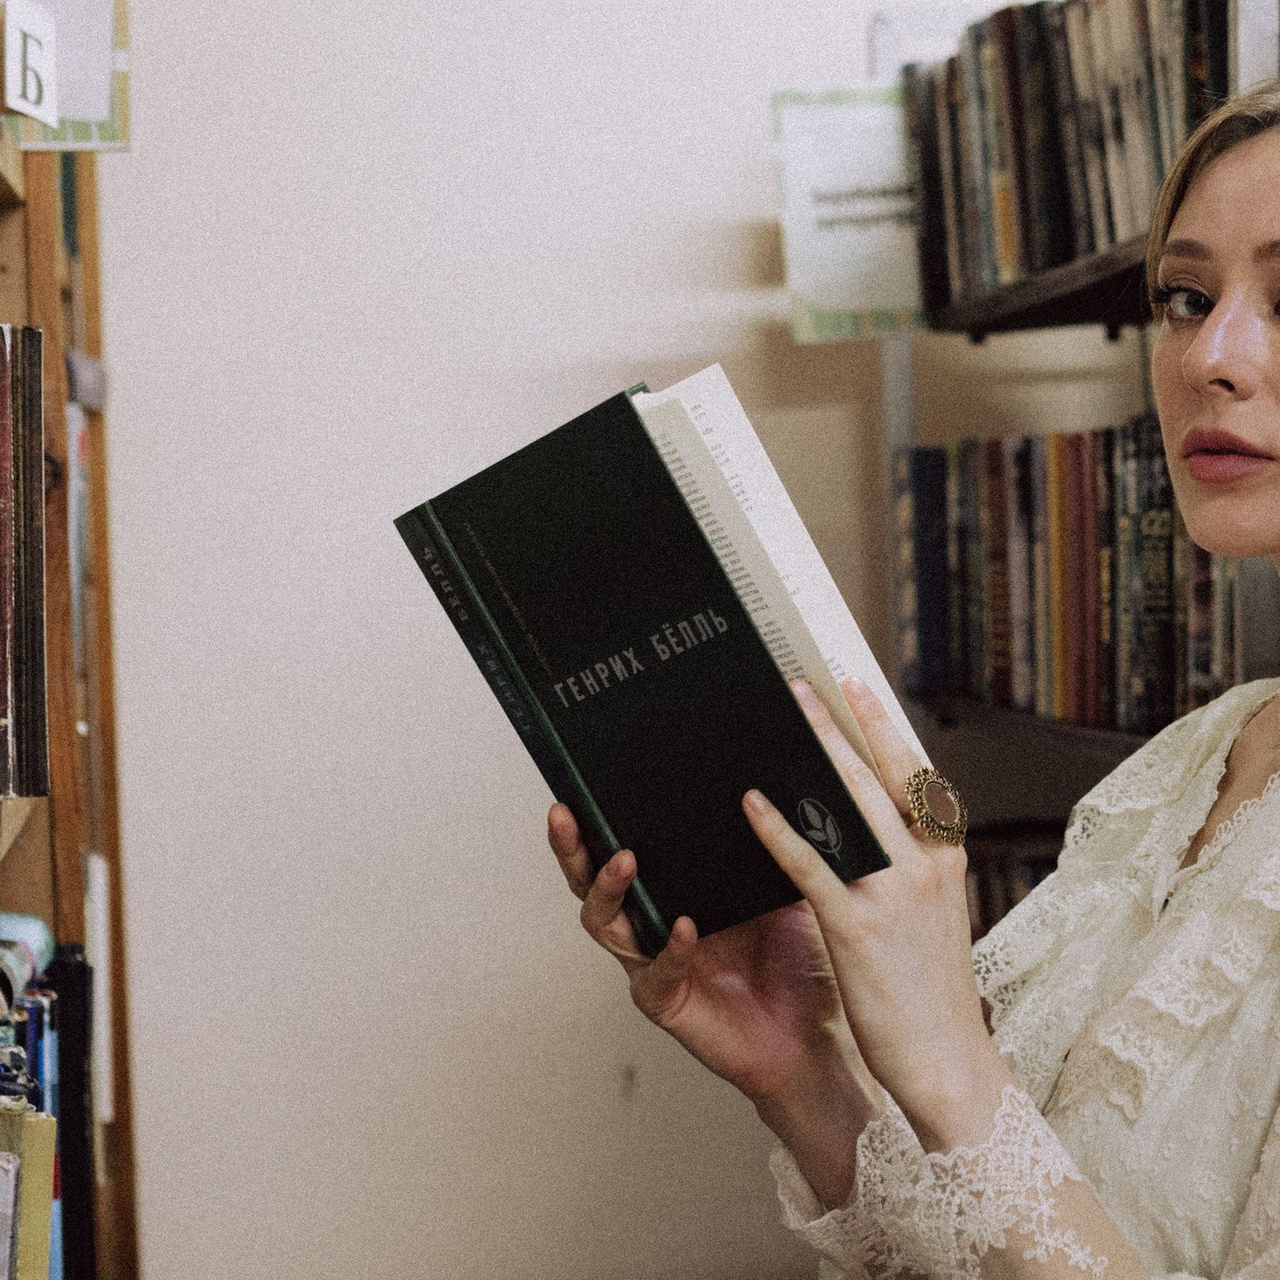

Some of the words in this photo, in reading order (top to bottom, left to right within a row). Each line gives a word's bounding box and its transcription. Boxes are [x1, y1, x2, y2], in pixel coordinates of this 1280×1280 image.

[18, 29, 45, 108] Б
[552, 646, 646, 710] ГЕНРИХ
[649, 607, 731, 662] БЁЛЛЬ
